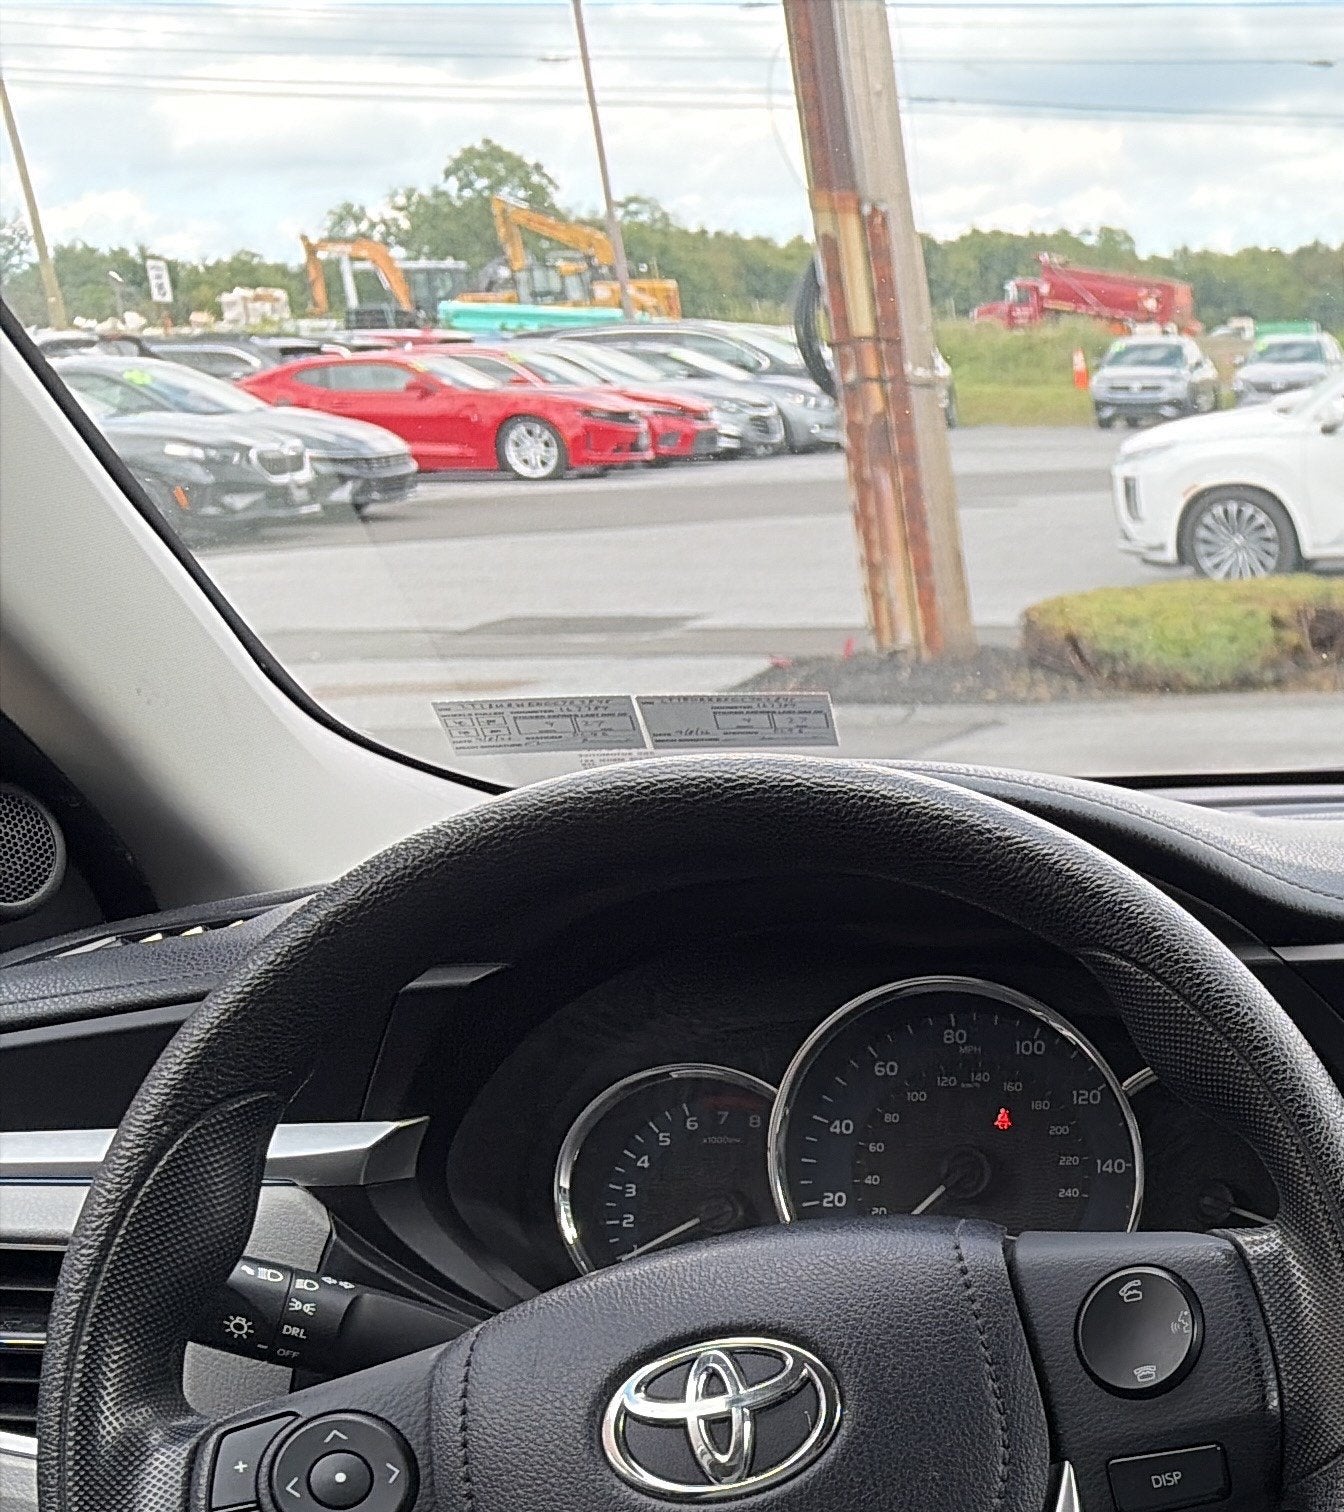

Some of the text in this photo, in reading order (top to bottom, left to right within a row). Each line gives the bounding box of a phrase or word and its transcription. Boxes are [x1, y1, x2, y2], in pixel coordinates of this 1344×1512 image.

[943, 1030, 967, 1044] 80
[1016, 1041, 1045, 1055] 100
[875, 1062, 898, 1076] 60
[937, 1077, 957, 1087] 120
[971, 1073, 990, 1082] 140
[1003, 1082, 1022, 1092] 160
[907, 1092, 927, 1101] 100
[1073, 1091, 1100, 1105] 120
[1032, 1101, 1050, 1110] 180
[687, 1117, 698, 1130] 6
[718, 1112, 729, 1125] 7
[750, 1115, 761, 1128] 8
[885, 1114, 900, 1123] 80
[830, 1120, 854, 1135] 40
[1050, 1126, 1069, 1136] 200
[659, 1133, 671, 1146] 5
[869, 1143, 884, 1152] 60
[637, 1155, 649, 1168] 4
[1060, 1156, 1079, 1166] 220
[1097, 1159, 1125, 1174] 140
[865, 1176, 880, 1185] 40
[625, 1184, 637, 1197] 3
[1059, 1189, 1079, 1198] 240
[823, 1192, 847, 1207] 20
[623, 1214, 635, 1228] 2
[282, 1325, 307, 1339] DRL
[277, 1349, 300, 1358] OFF
[1151, 1471, 1182, 1489] DISP
